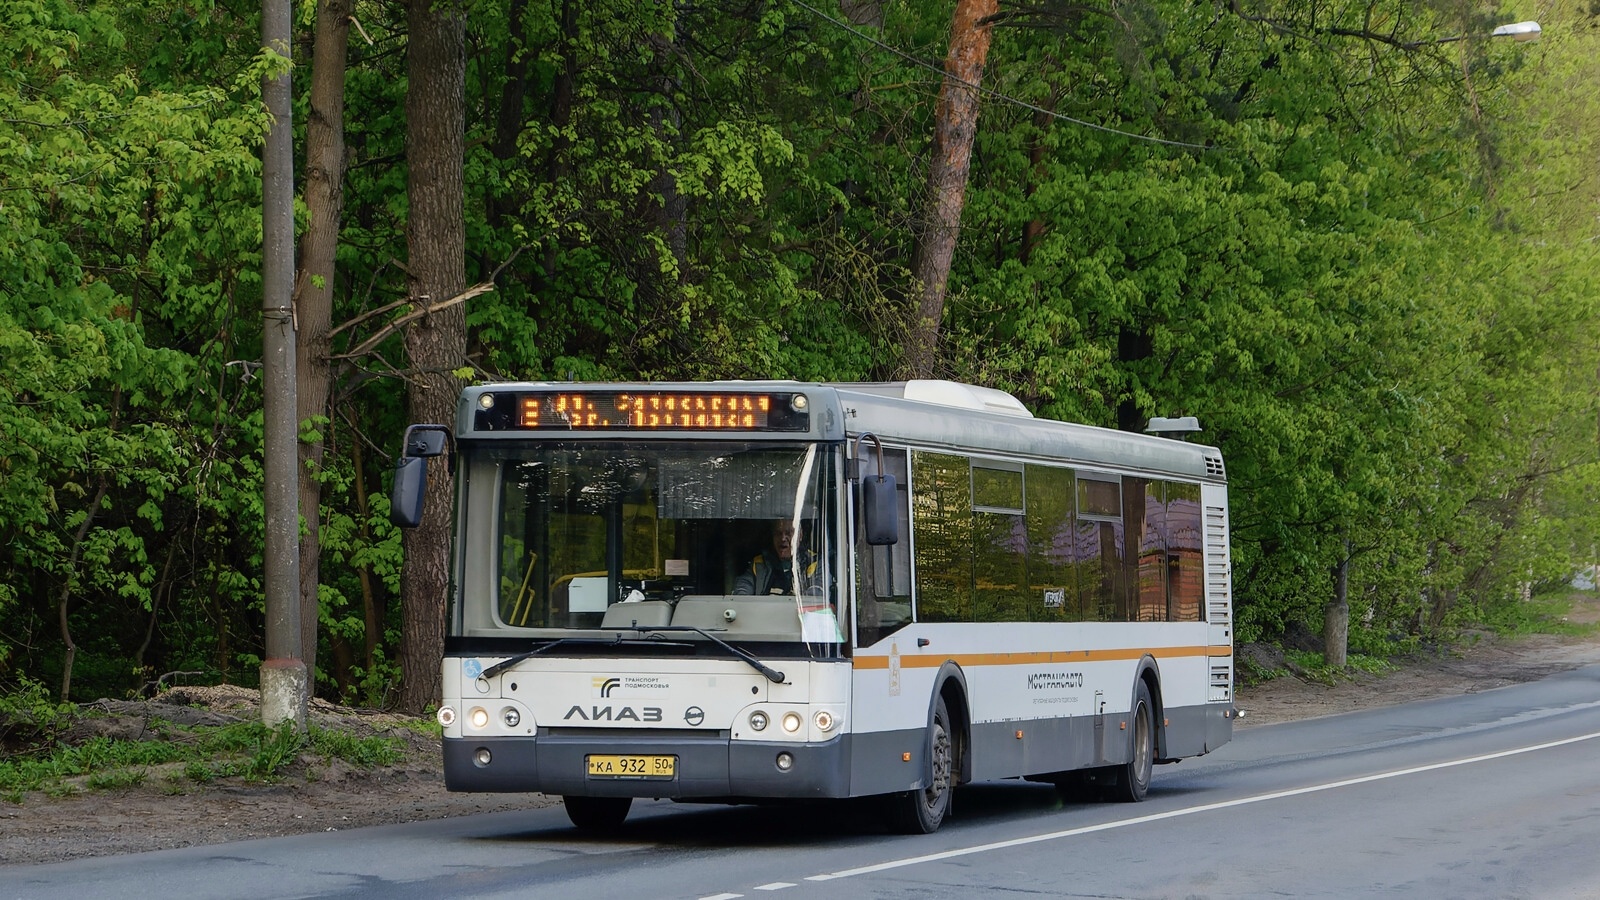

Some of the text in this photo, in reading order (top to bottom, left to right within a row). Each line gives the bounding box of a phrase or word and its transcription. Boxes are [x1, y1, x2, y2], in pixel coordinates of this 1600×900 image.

[1027, 672, 1083, 689] МОСТРАНСАВТО
[563, 705, 663, 722] ЛИАЗ
[620, 759, 646, 773] 932
[655, 758, 669, 769] 50
